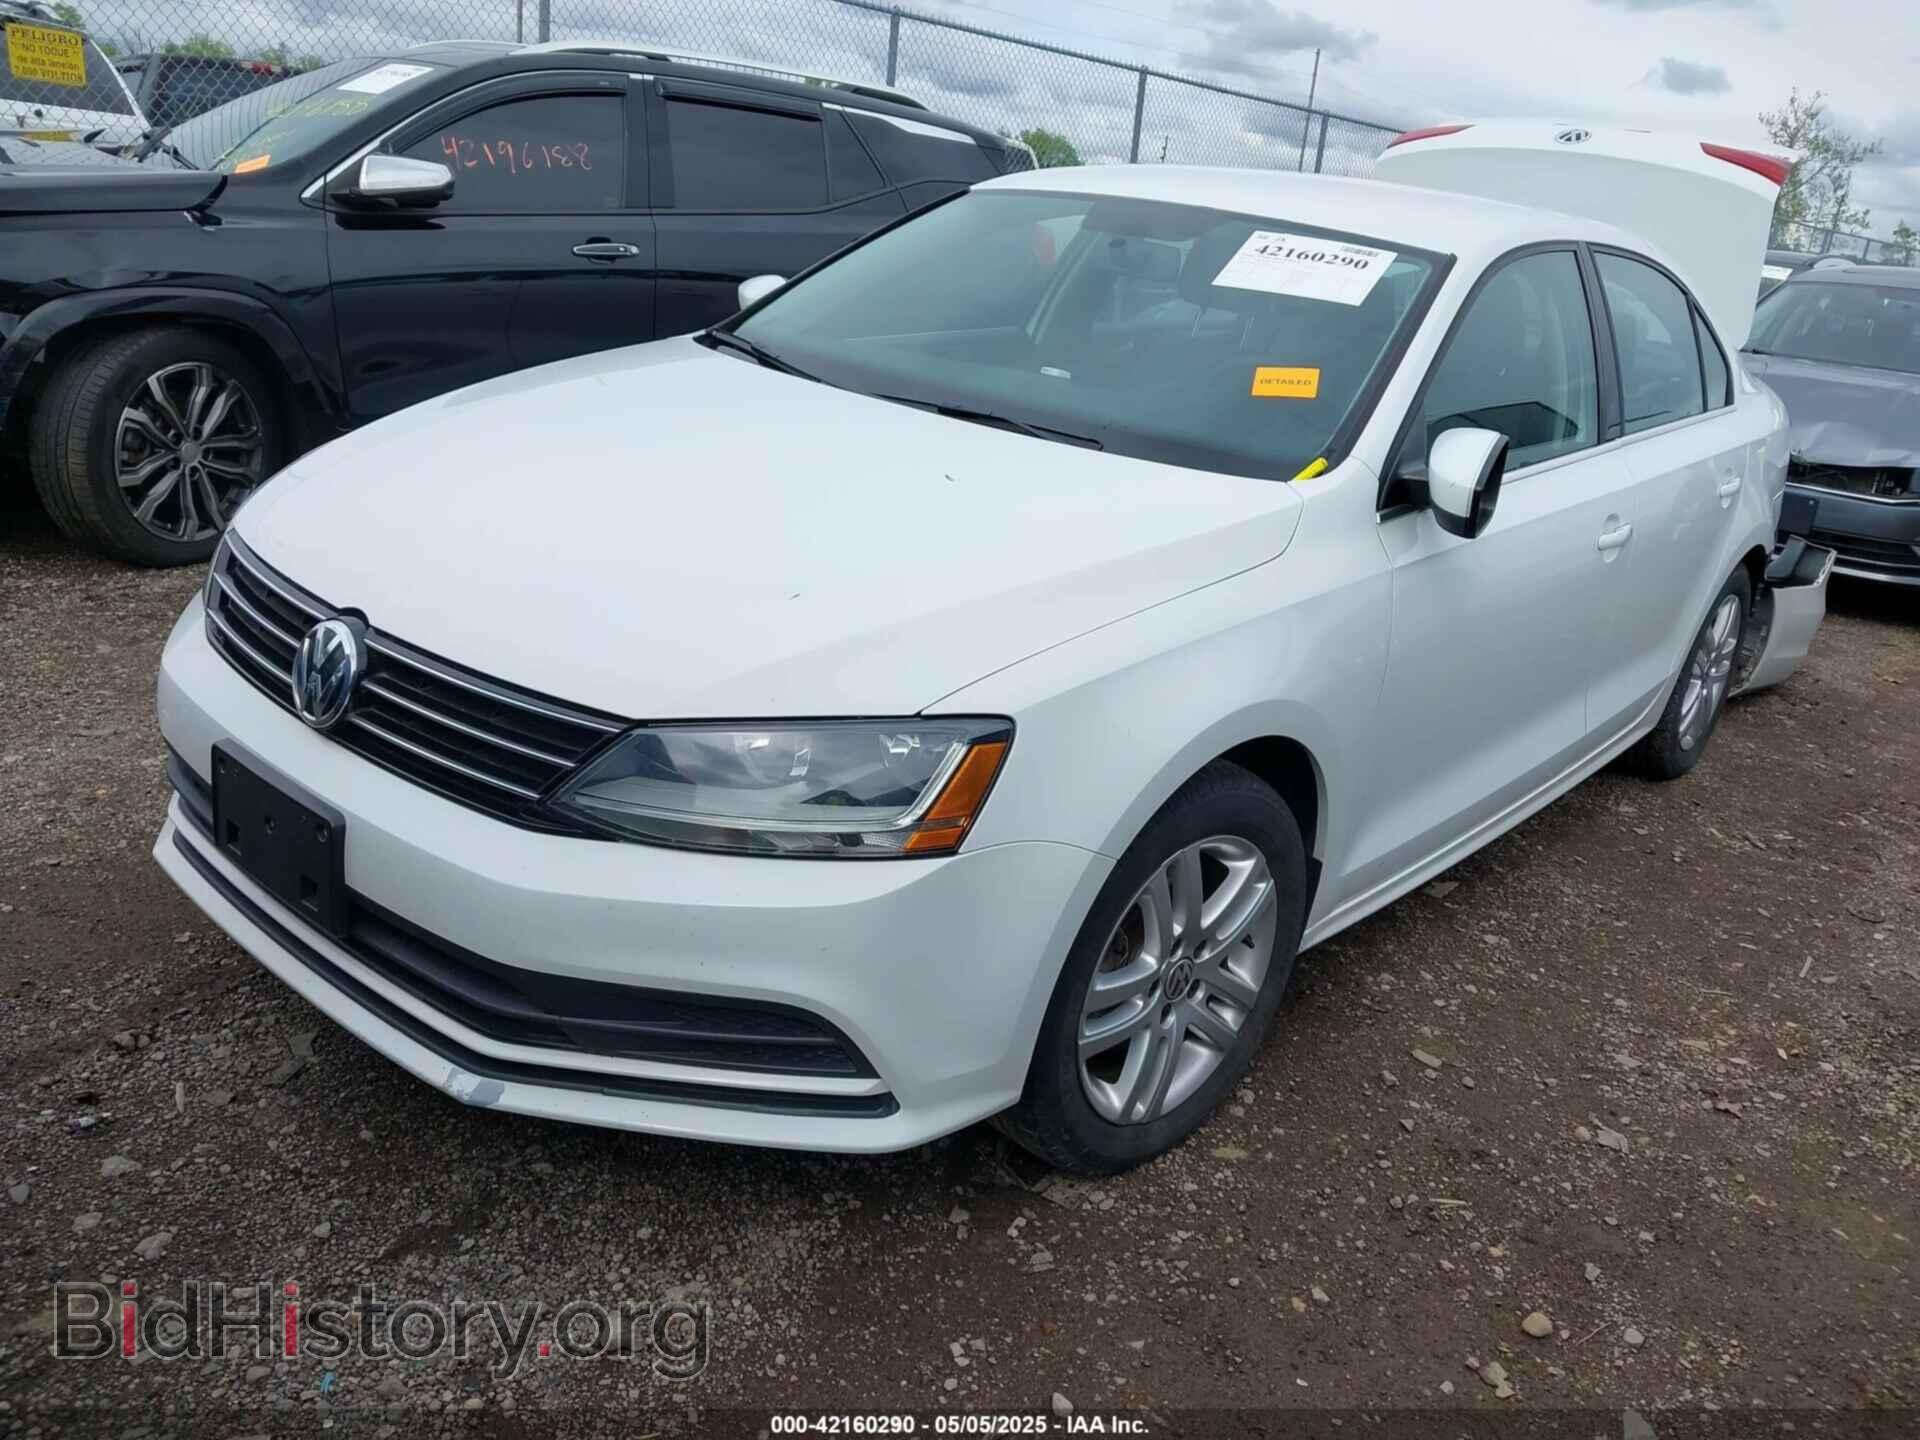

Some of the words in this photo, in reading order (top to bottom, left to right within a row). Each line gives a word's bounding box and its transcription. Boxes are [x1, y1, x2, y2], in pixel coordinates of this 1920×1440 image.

[11, 27, 79, 46] PELIGRO
[21, 41, 36, 53] NO
[39, 45, 71, 58] TOQUE
[441, 136, 593, 175] 42196188
[1255, 244, 1369, 270] 42160290
[1259, 377, 1312, 387] DETAILED
